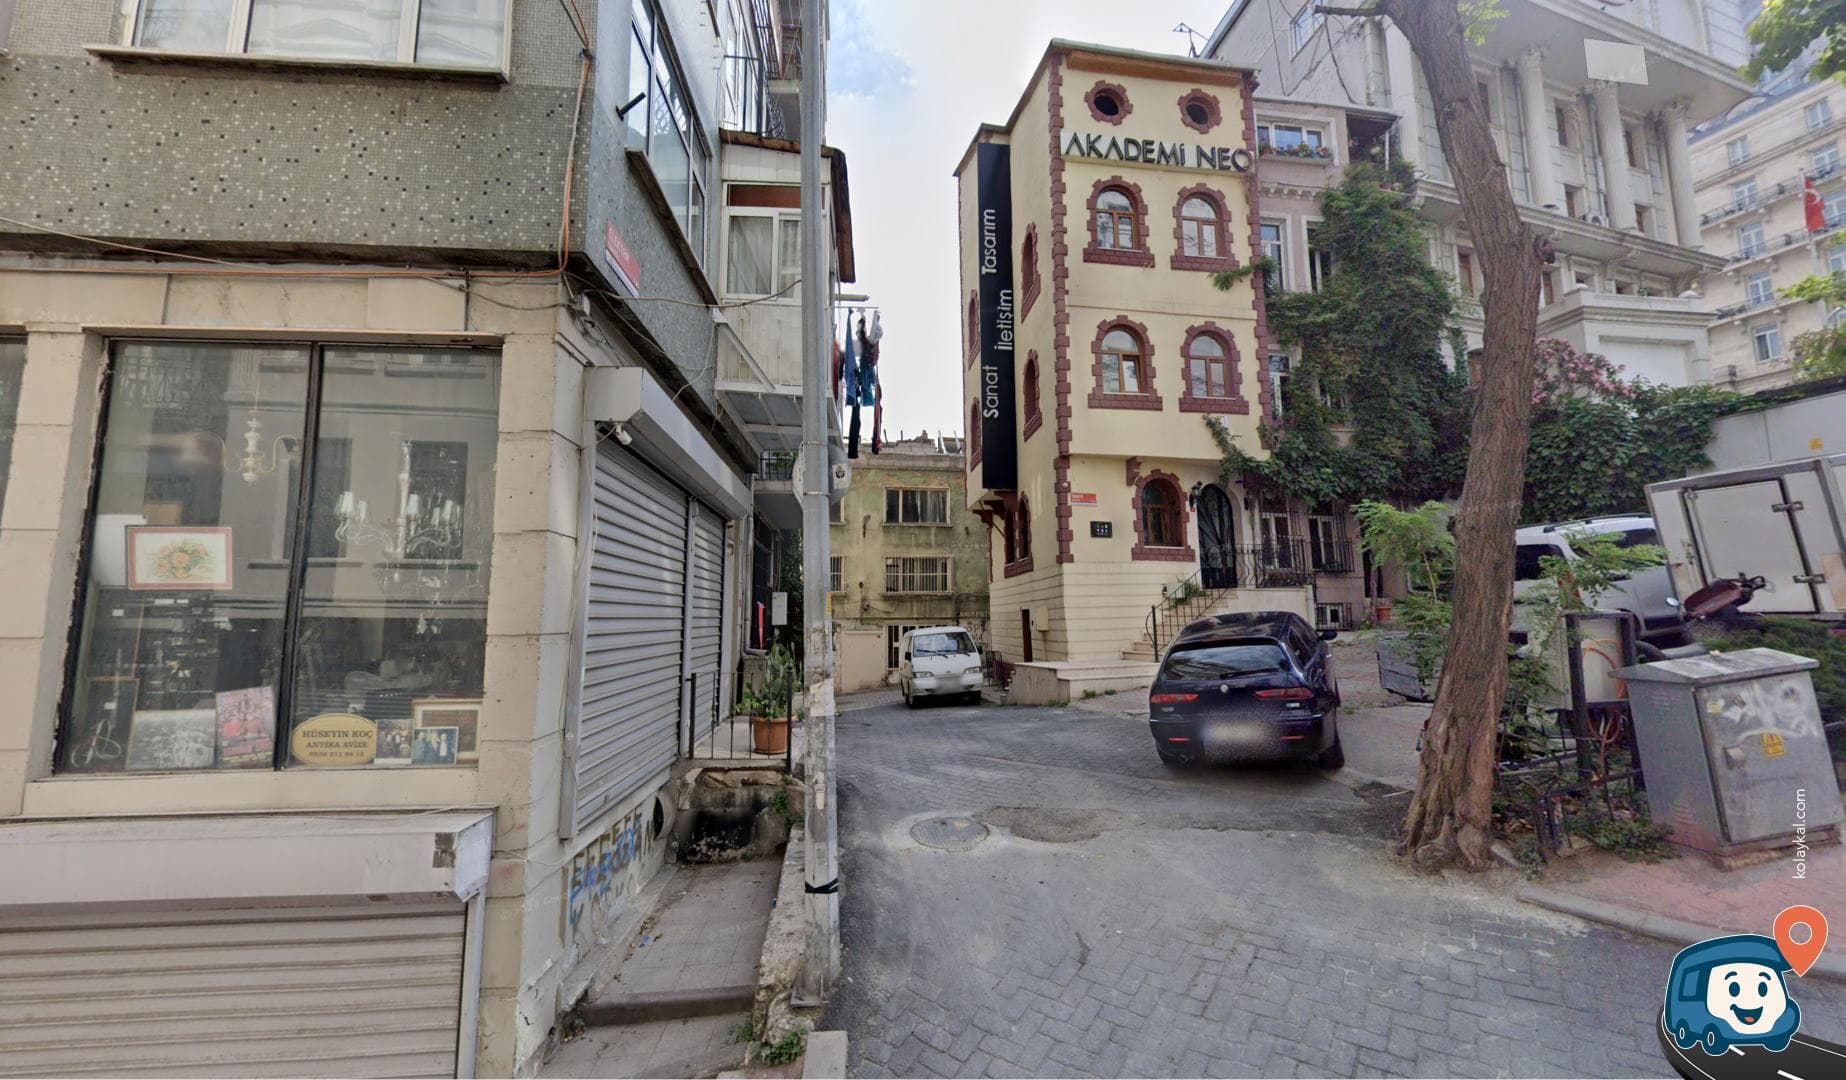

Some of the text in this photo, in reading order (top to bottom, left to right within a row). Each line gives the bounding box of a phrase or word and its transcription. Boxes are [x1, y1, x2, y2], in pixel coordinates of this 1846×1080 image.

[1196, 145, 1253, 172] NEO
[981, 209, 997, 275] Tasarım
[982, 365, 998, 418] Sanat
[302, 729, 373, 739] HÜSEYİN KOÇ
[306, 741, 368, 749] ANTİKA AVİZE
